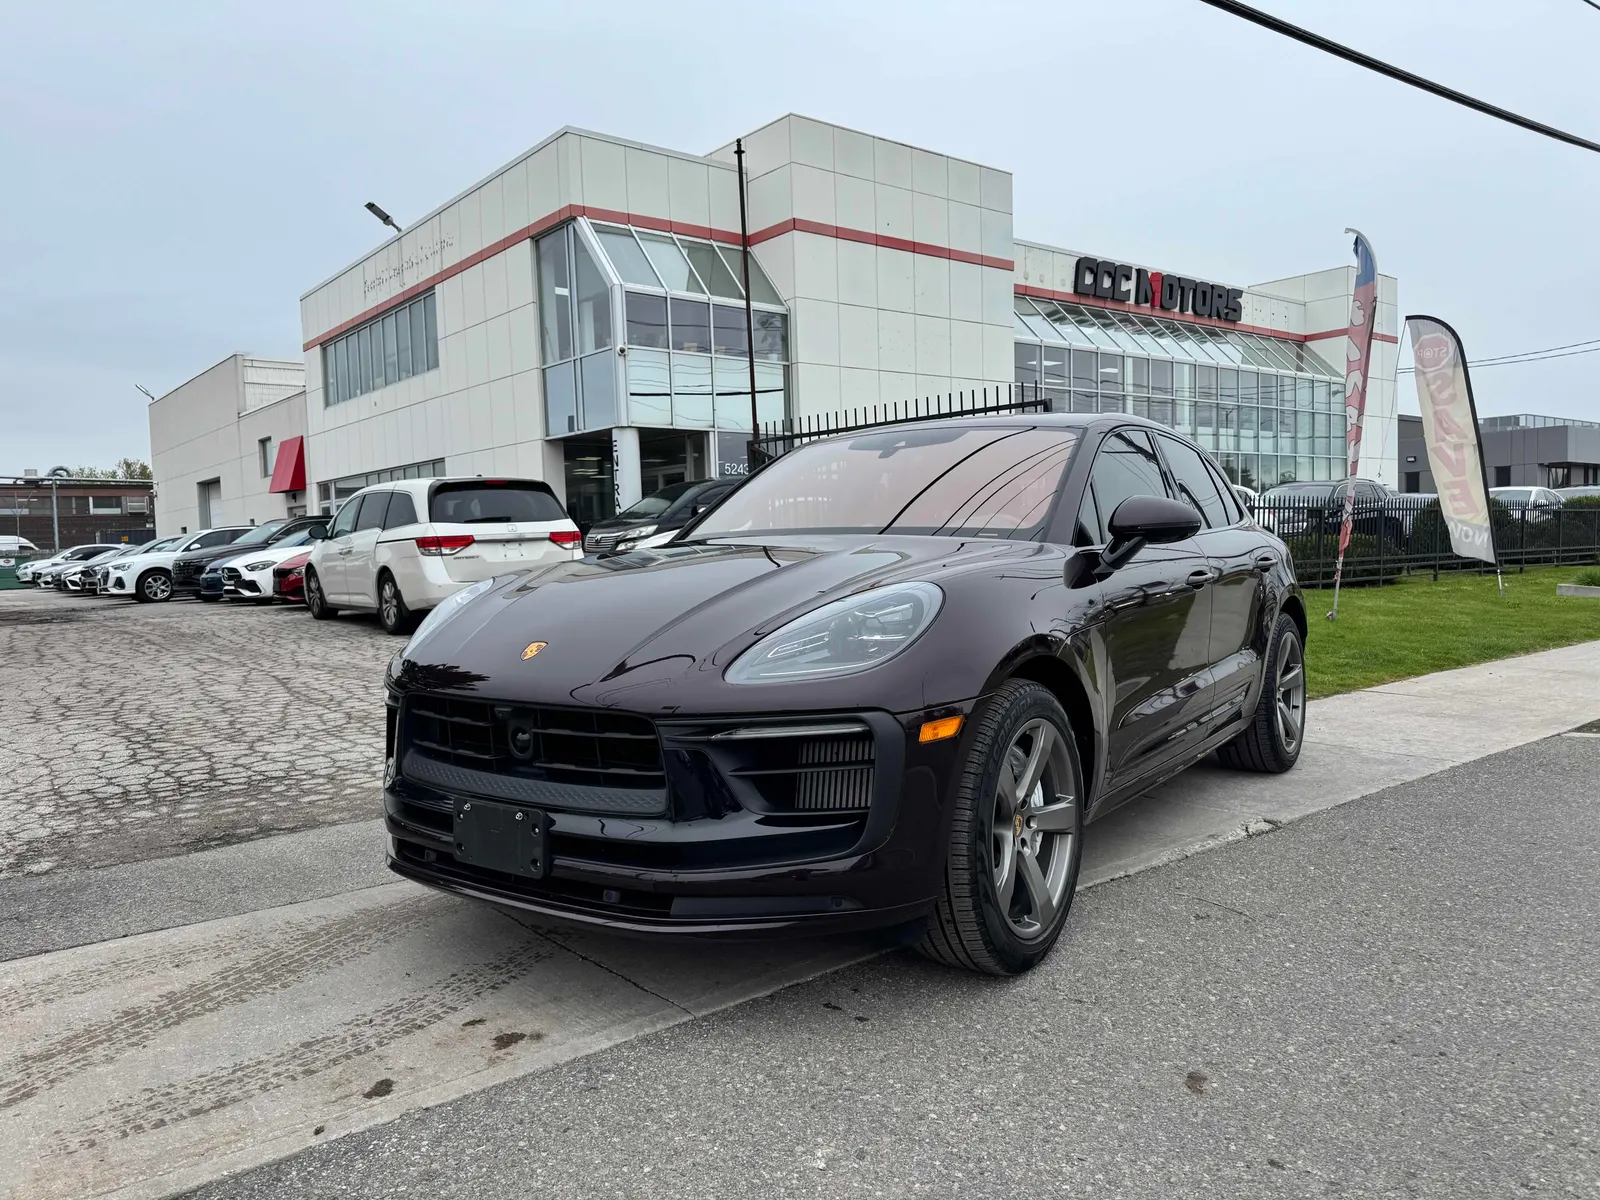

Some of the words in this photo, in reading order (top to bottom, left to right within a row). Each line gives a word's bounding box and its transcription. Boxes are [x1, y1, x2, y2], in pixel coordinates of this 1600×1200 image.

[1074, 256, 1133, 301] CCC
[1135, 267, 1243, 322] MOTORS
[612, 440, 622, 516] ENTRA
[724, 463, 749, 475] 5243
